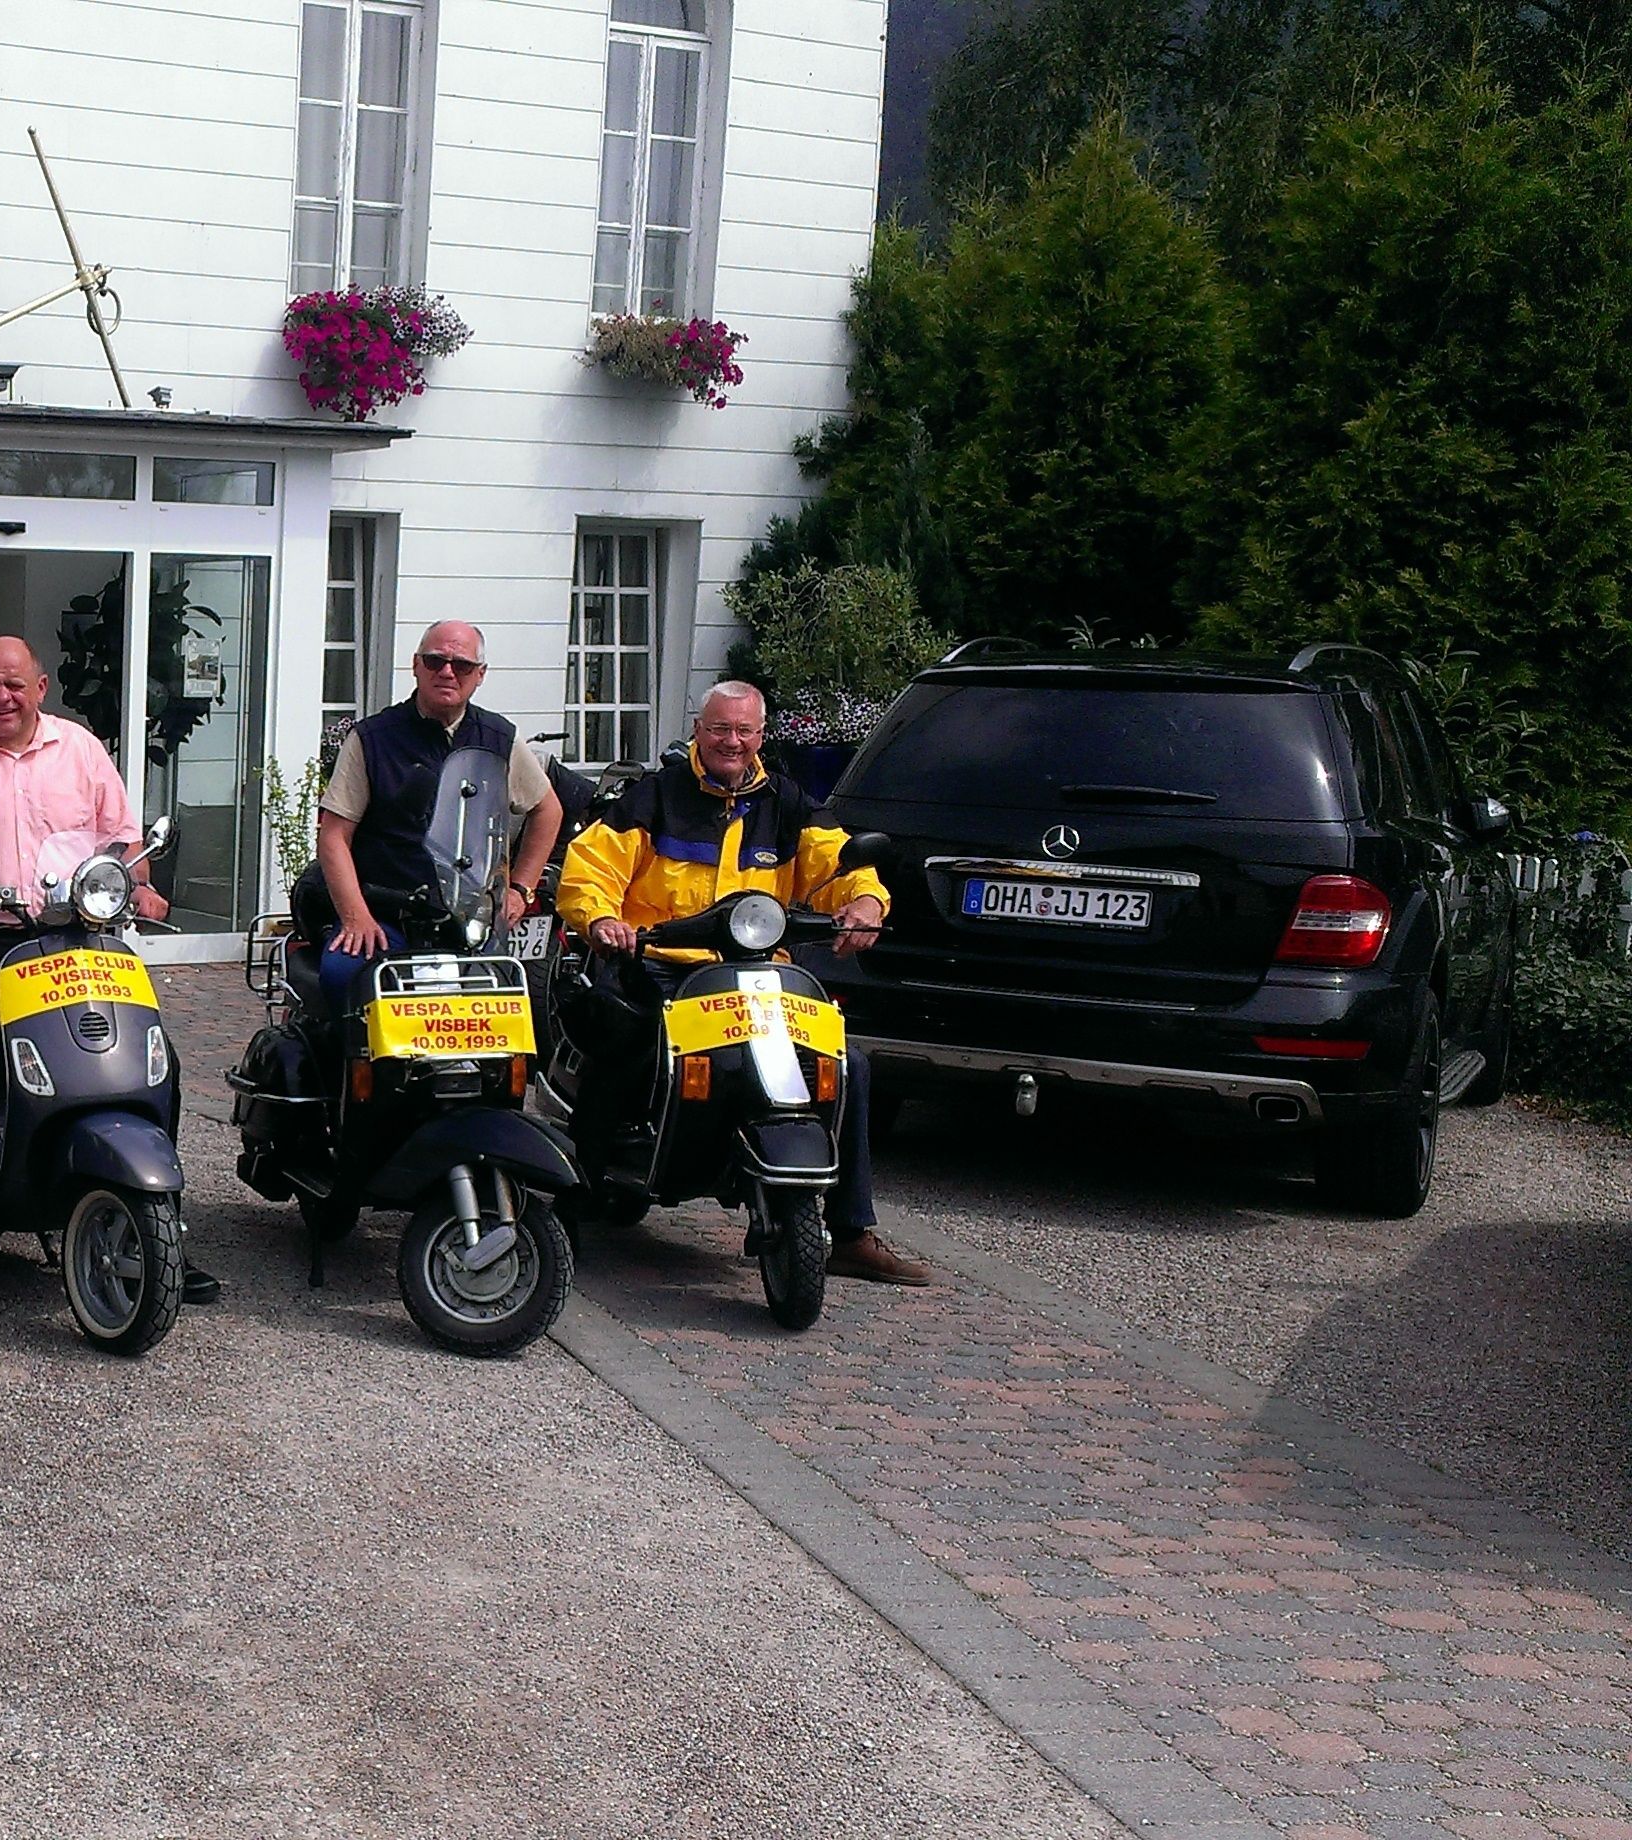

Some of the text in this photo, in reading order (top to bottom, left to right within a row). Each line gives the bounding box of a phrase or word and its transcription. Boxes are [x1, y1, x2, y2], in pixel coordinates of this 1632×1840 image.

[984, 884, 1148, 922] OHA JJ 123
[532, 938, 543, 957] 6
[15, 955, 78, 980] VESPA
[93, 955, 137, 972] CLUB
[50, 969, 116, 986] VISBEK
[40, 984, 133, 1004] 10.09.1993
[391, 1002, 453, 1017] VESPA
[471, 1002, 523, 1016] CLUB
[699, 995, 762, 1013] VESPA
[780, 996, 818, 1017] CLUB
[424, 1018, 492, 1033] VISBEK
[734, 1009, 798, 1026] VIBEK
[411, 1035, 509, 1049] 10.09.1993
[723, 1024, 811, 1043] 10.09993
